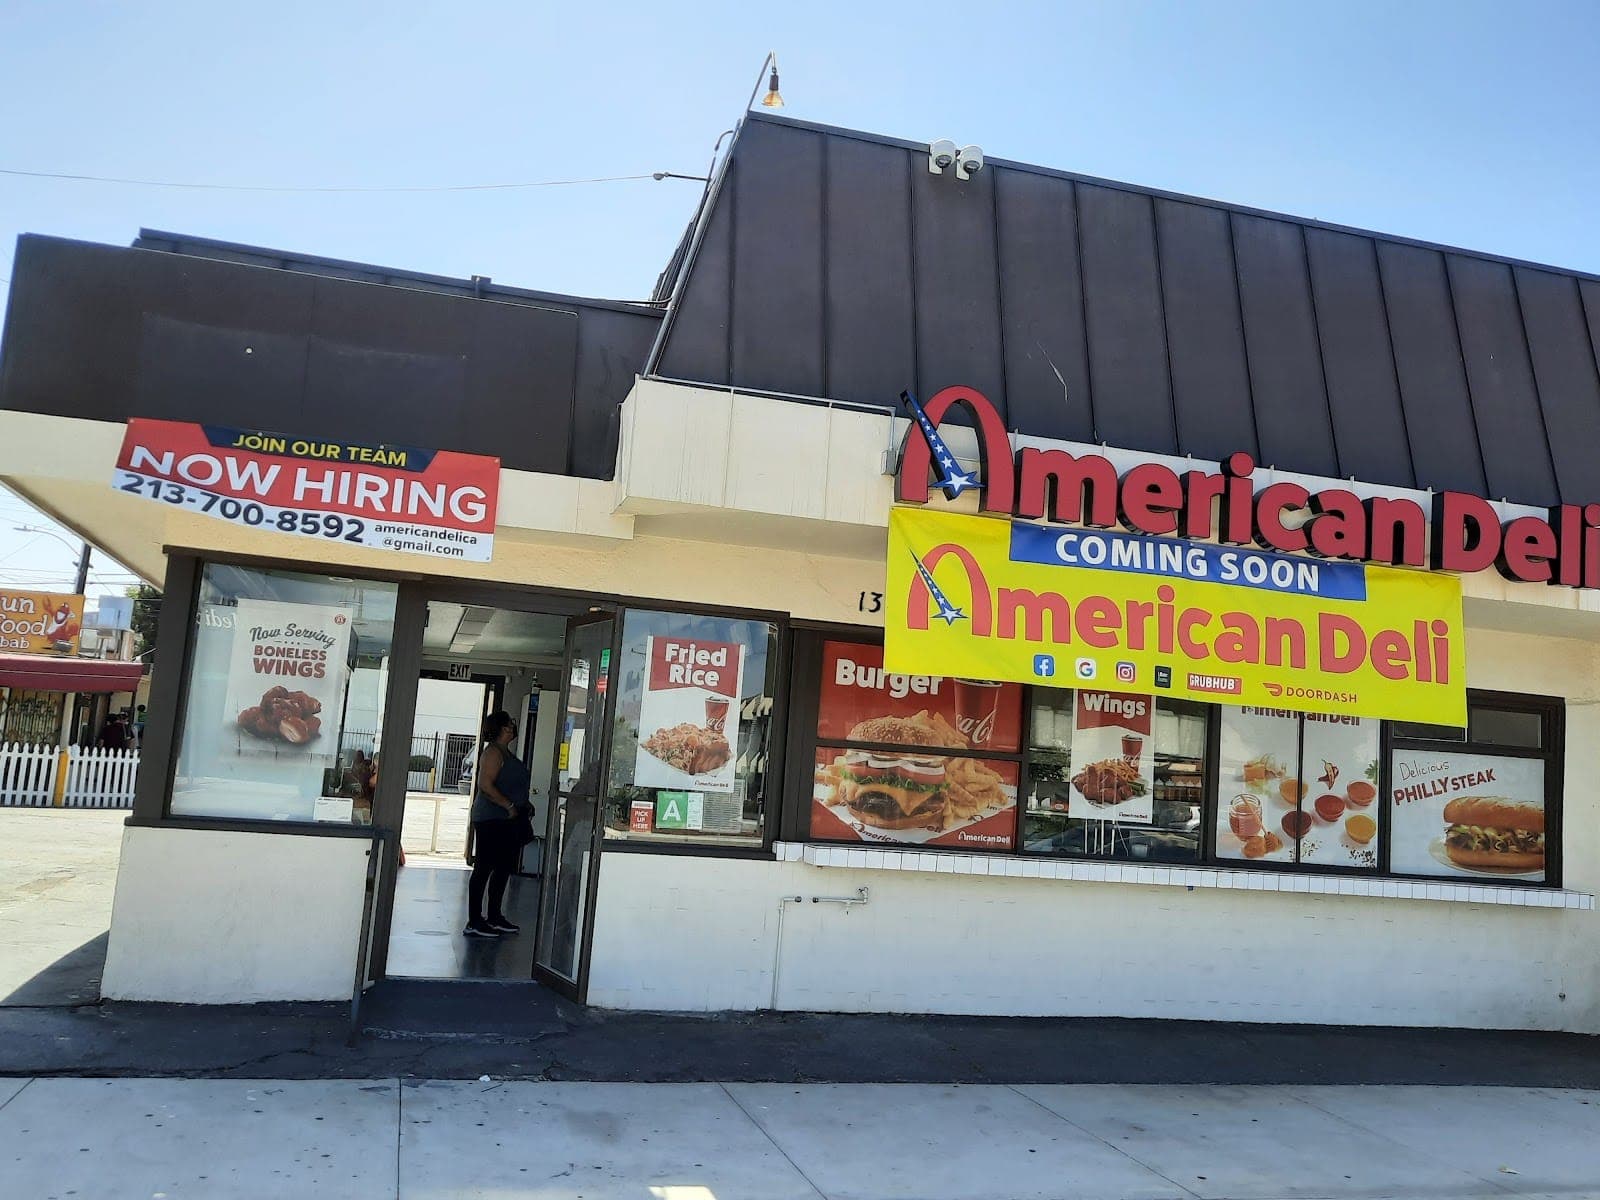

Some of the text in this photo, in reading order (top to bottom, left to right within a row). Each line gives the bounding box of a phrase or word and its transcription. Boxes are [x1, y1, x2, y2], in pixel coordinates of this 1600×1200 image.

[232, 433, 407, 467] JOIN OUR TEAM
[129, 445, 487, 524] NOW HIRING
[896, 385, 1600, 589] American Deli
[120, 473, 366, 543] 213-700-8592
[374, 521, 478, 546] americandelica
[382, 535, 465, 558] @gmail.com
[1055, 533, 1320, 592] COMING SOON
[907, 543, 1450, 685] American Deli
[250, 623, 337, 649] Now Serving
[254, 644, 328, 661] BONELESS
[665, 643, 727, 667] Fried
[253, 657, 326, 679] WINGS
[450, 663, 470, 678] EXIT
[669, 664, 720, 687] Rice
[835, 658, 944, 699] Burger
[1189, 674, 1235, 690] GRUBHUB
[1083, 693, 1147, 719] Wings
[1286, 686, 1358, 704] DOORDASH
[1400, 760, 1450, 780] Delicious
[1393, 768, 1497, 806] PHILLY STEAK
[662, 799, 681, 821] A
